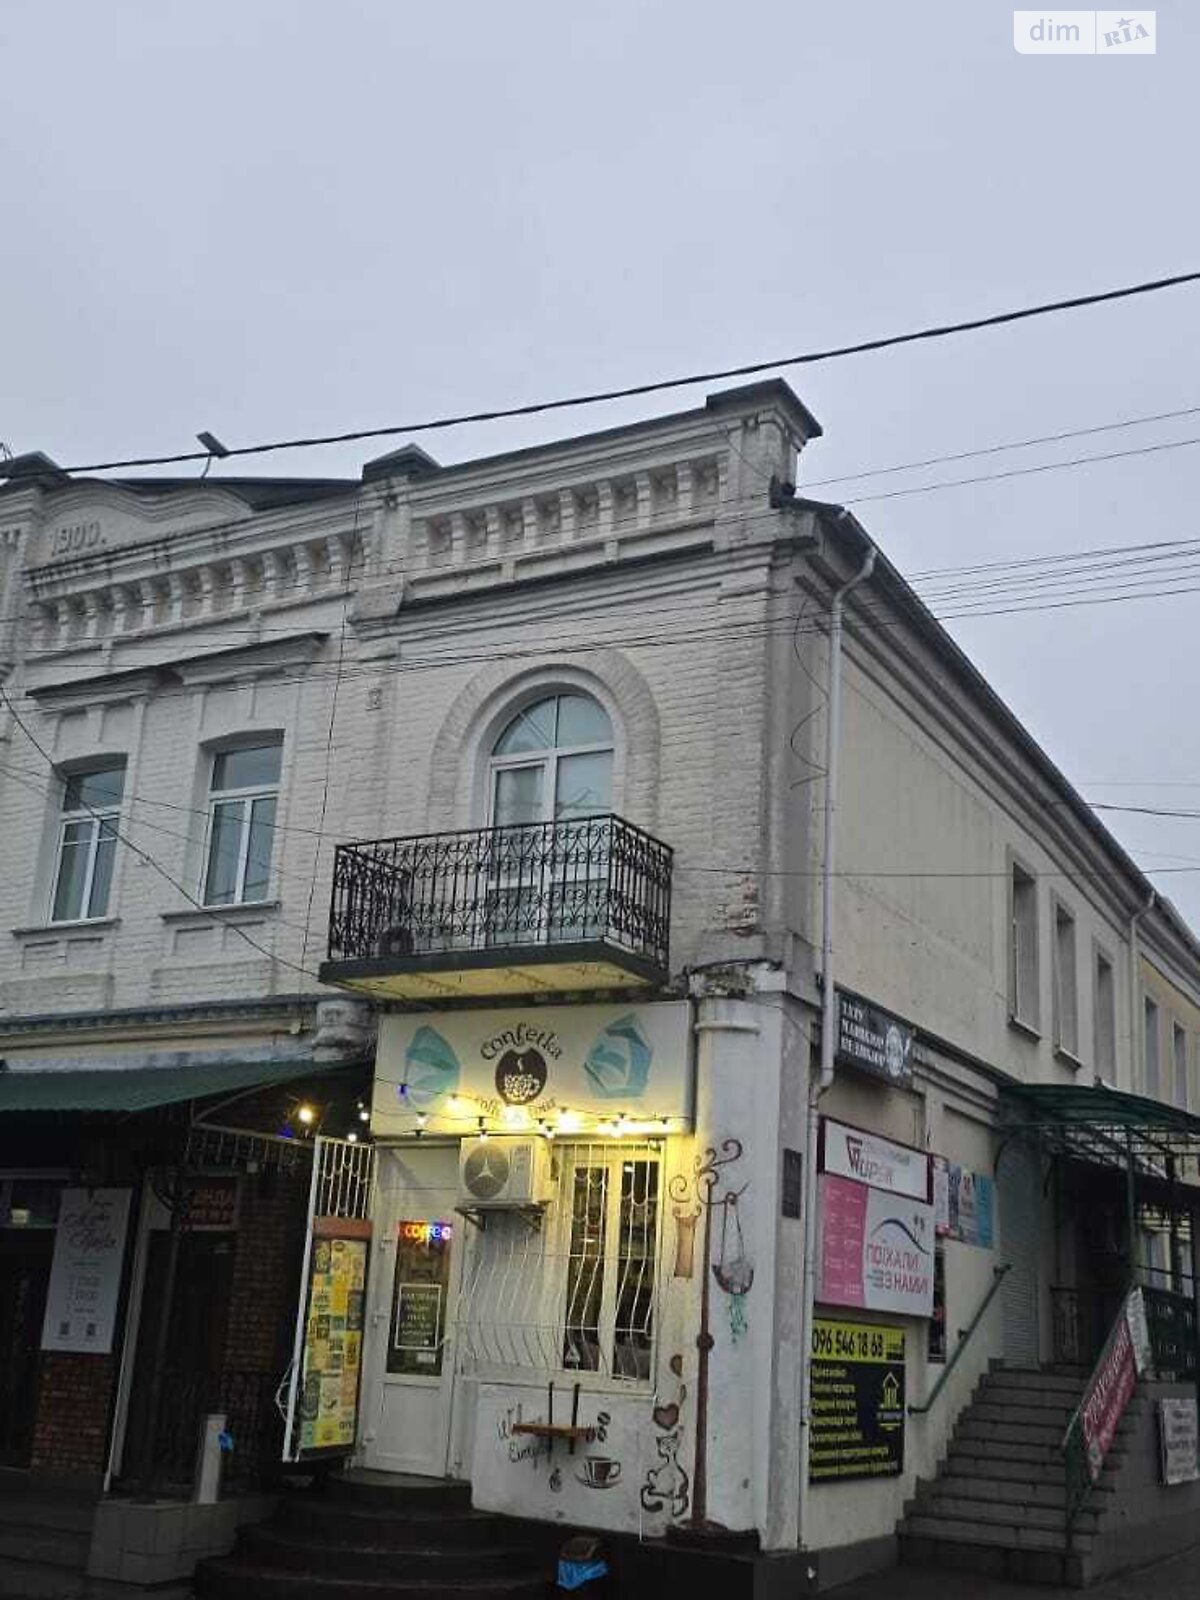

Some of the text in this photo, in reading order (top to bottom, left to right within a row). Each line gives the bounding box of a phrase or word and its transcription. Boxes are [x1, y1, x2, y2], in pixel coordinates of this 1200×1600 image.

[404, 1225, 451, 1244] coffee
[867, 1239, 920, 1269] ПОЇХАЛИ
[894, 1274, 929, 1294] НАМИ
[812, 1328, 832, 1353] 096
[835, 1330, 855, 1355] 546
[858, 1332, 868, 1358] 18
